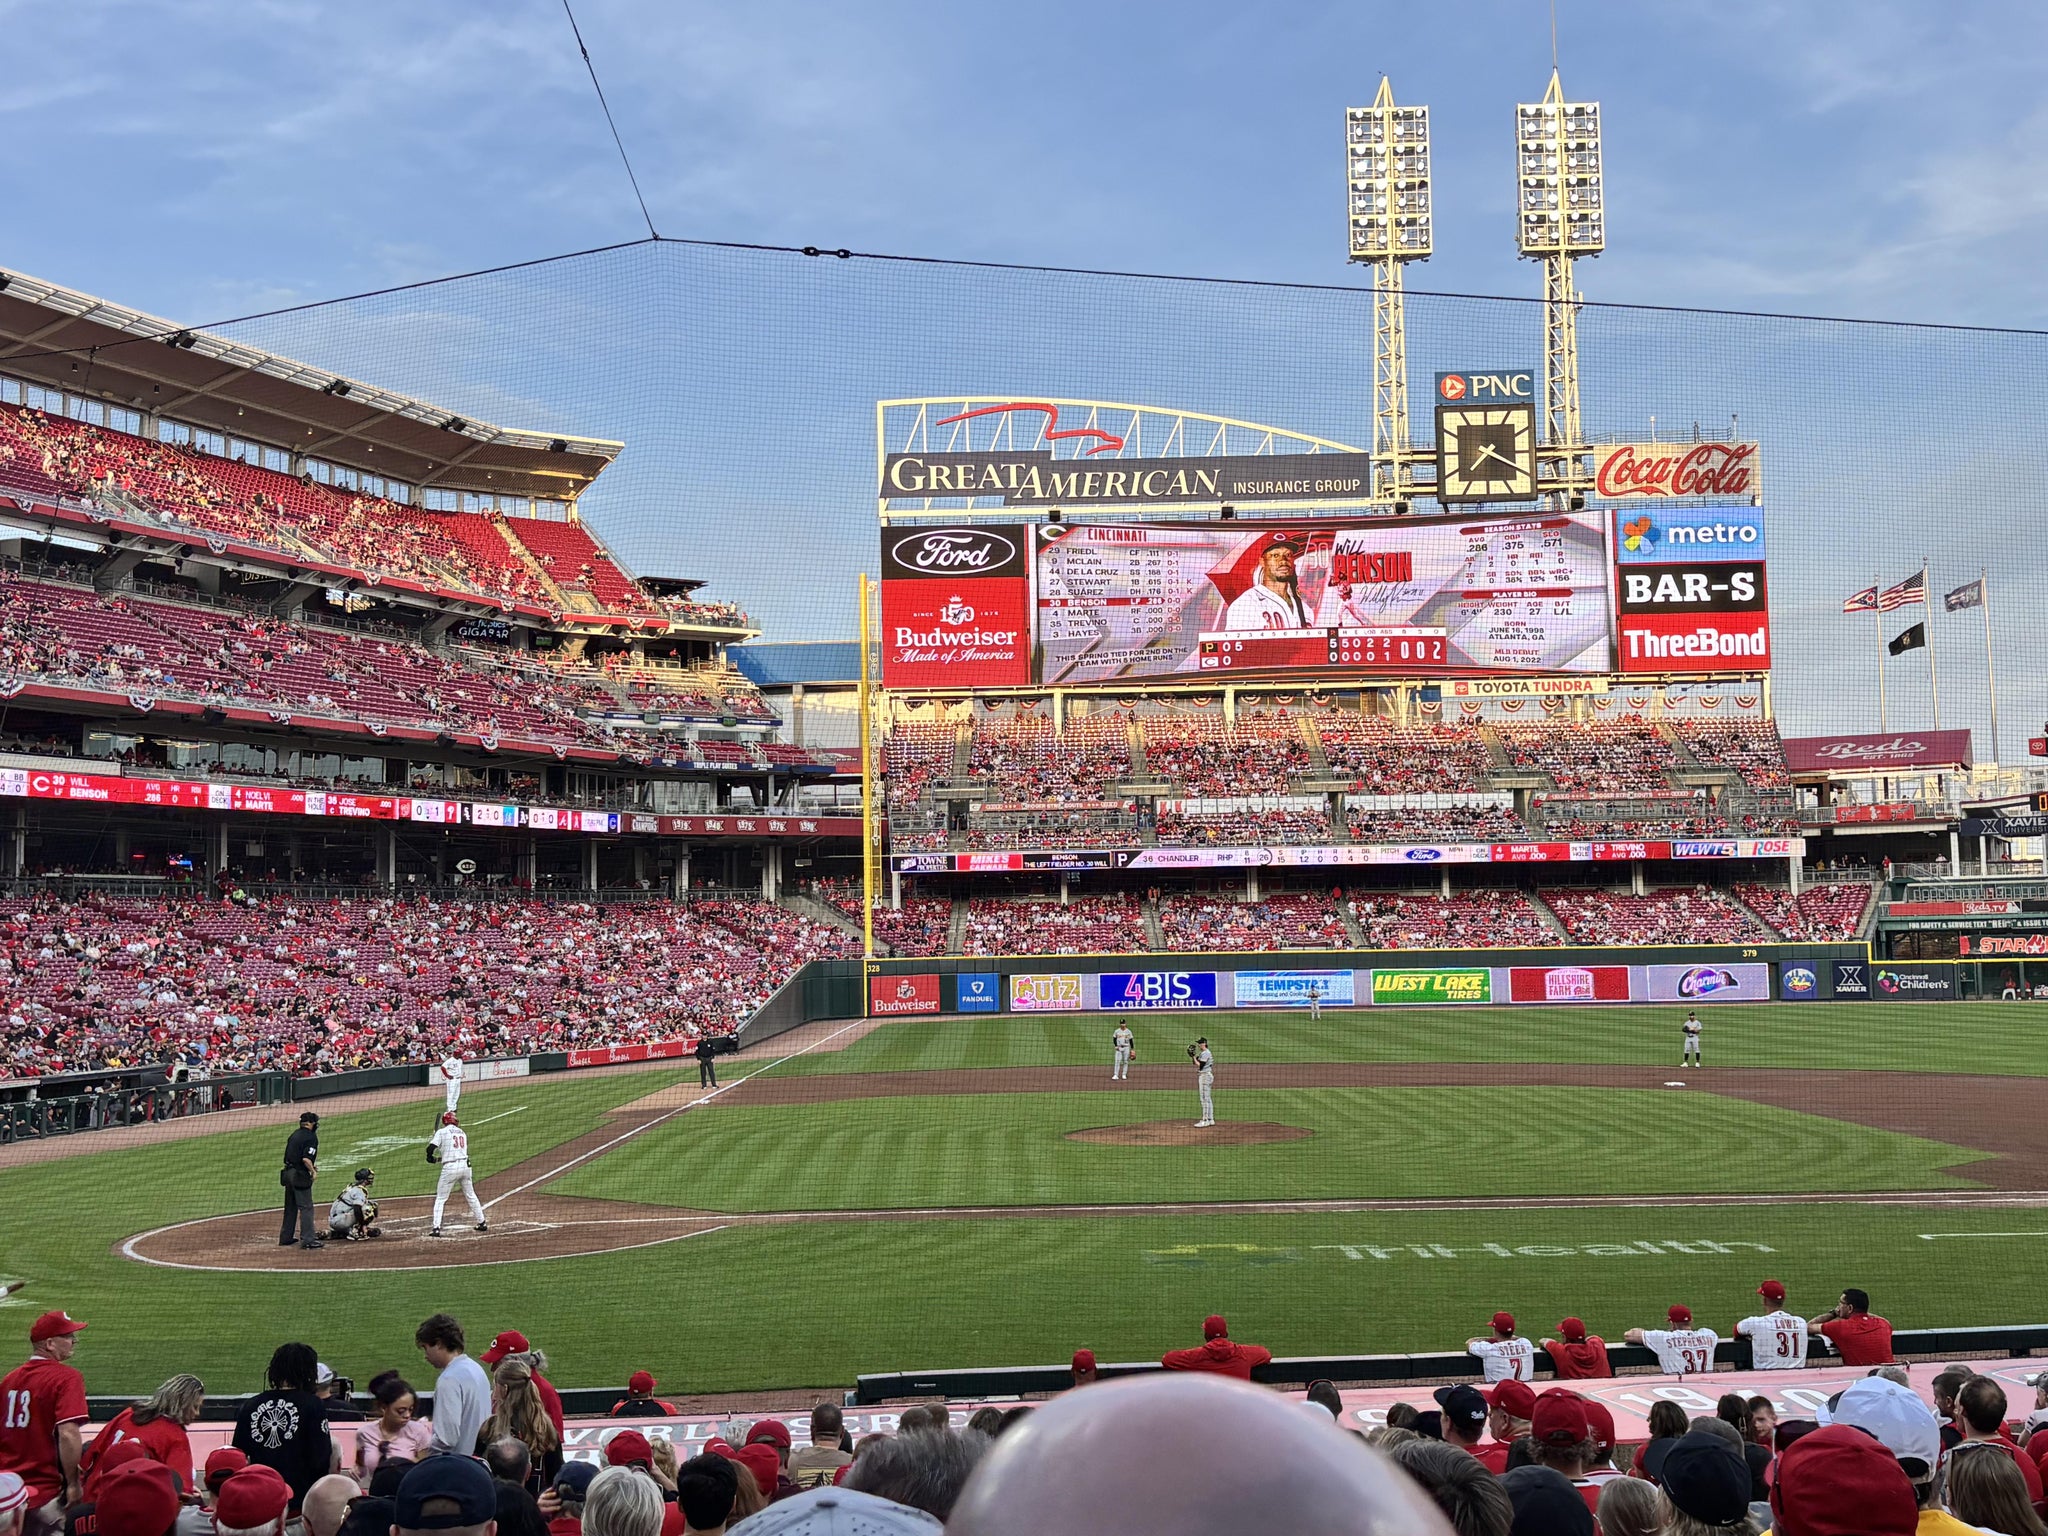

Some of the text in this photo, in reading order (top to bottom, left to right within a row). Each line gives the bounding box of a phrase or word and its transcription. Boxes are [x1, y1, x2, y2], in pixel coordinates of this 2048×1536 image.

[1469, 374, 1530, 397] PNC
[1597, 444, 1757, 497] Coca-Cola
[1233, 479, 1361, 494] INSURANCE GROUP
[1484, 523, 1542, 534] SEASON STATS
[1668, 522, 1758, 544] metro
[1088, 529, 1147, 542] CINCINNATI
[1466, 538, 1563, 552] .286 .375 .571
[916, 536, 992, 566] Ford
[1095, 568, 1118, 576] CRUZ
[1333, 552, 1413, 583] BENSON
[1066, 578, 1111, 586] STEWART
[1067, 588, 1104, 596] SUÁREZ
[1625, 572, 1755, 604] BAR-S
[1492, 590, 1522, 598] PLAYER
[1049, 598, 1107, 607] 30 BENSON
[1067, 609, 1099, 617] MARTE
[1493, 608, 1512, 616] 230
[1529, 608, 1541, 616] 27
[1067, 618, 1107, 626] TREVINO
[895, 626, 1018, 647] Budweiser
[1067, 629, 1100, 637] HAYES
[1222, 638, 1391, 652] 0 5 5 5 0 2 2
[1624, 628, 1765, 658] ThreeBond
[893, 647, 1015, 664] Made of America
[1400, 641, 1441, 659] 0 0 2
[1513, 648, 1539, 656] DEBUT
[1078, 652, 1109, 660] SPRING
[1329, 652, 1375, 662] 0 0 0 0
[1100, 658, 1122, 666] WITH
[1474, 680, 1593, 694] TOYOTA TUNDRA
[1815, 737, 1927, 759] Reds
[52, 775, 90, 787] 30 WILL
[69, 787, 108, 799] BENSON
[145, 783, 202, 794] AVG RBI
[144, 793, 161, 803] .286
[245, 791, 271, 801] NOELVI
[245, 800, 274, 811] MARTE
[339, 797, 392, 808] JOSE .000
[339, 806, 371, 817] TREVINO
[1510, 846, 1539, 854] MARTE
[1610, 843, 1645, 851] TREVINO
[1752, 841, 1790, 856] ROSE
[1142, 854, 1234, 863] 36 CHANDLER RHP
[1411, 850, 1436, 860] Ford
[1528, 852, 1547, 860] .000
[1628, 850, 1646, 858] .000
[917, 856, 948, 865] TOWNE
[1024, 861, 1035, 869] THE
[1049, 860, 1073, 868] FIELDER
[1920, 922, 1942, 930] SAFETY
[1973, 921, 1987, 929] TEXT
[1742, 949, 1758, 958] 379
[867, 965, 881, 973] 328
[1373, 972, 1485, 992] WEST LAKE
[1548, 974, 1590, 985] HILLSHIRE
[1682, 972, 1726, 993] Charmin
[1899, 979, 1949, 990] Children's
[1124, 973, 1192, 1001] 4BIS
[1548, 985, 1571, 996] FARM
[962, 995, 994, 1003] FANDUEL
[1446, 990, 1482, 999] TIRES
[874, 999, 938, 1012] Budweiser
[1114, 999, 1204, 1008] CYBER SECURITY
[452, 1135, 465, 1149] 30
[1774, 1319, 1799, 1329] LOWE
[1498, 1344, 1527, 1356] STEER
[1776, 1332, 1800, 1359] 31
[1681, 1349, 1709, 1374] 37
[1508, 1358, 1523, 1381] 7
[5, 1389, 31, 1429] 13
